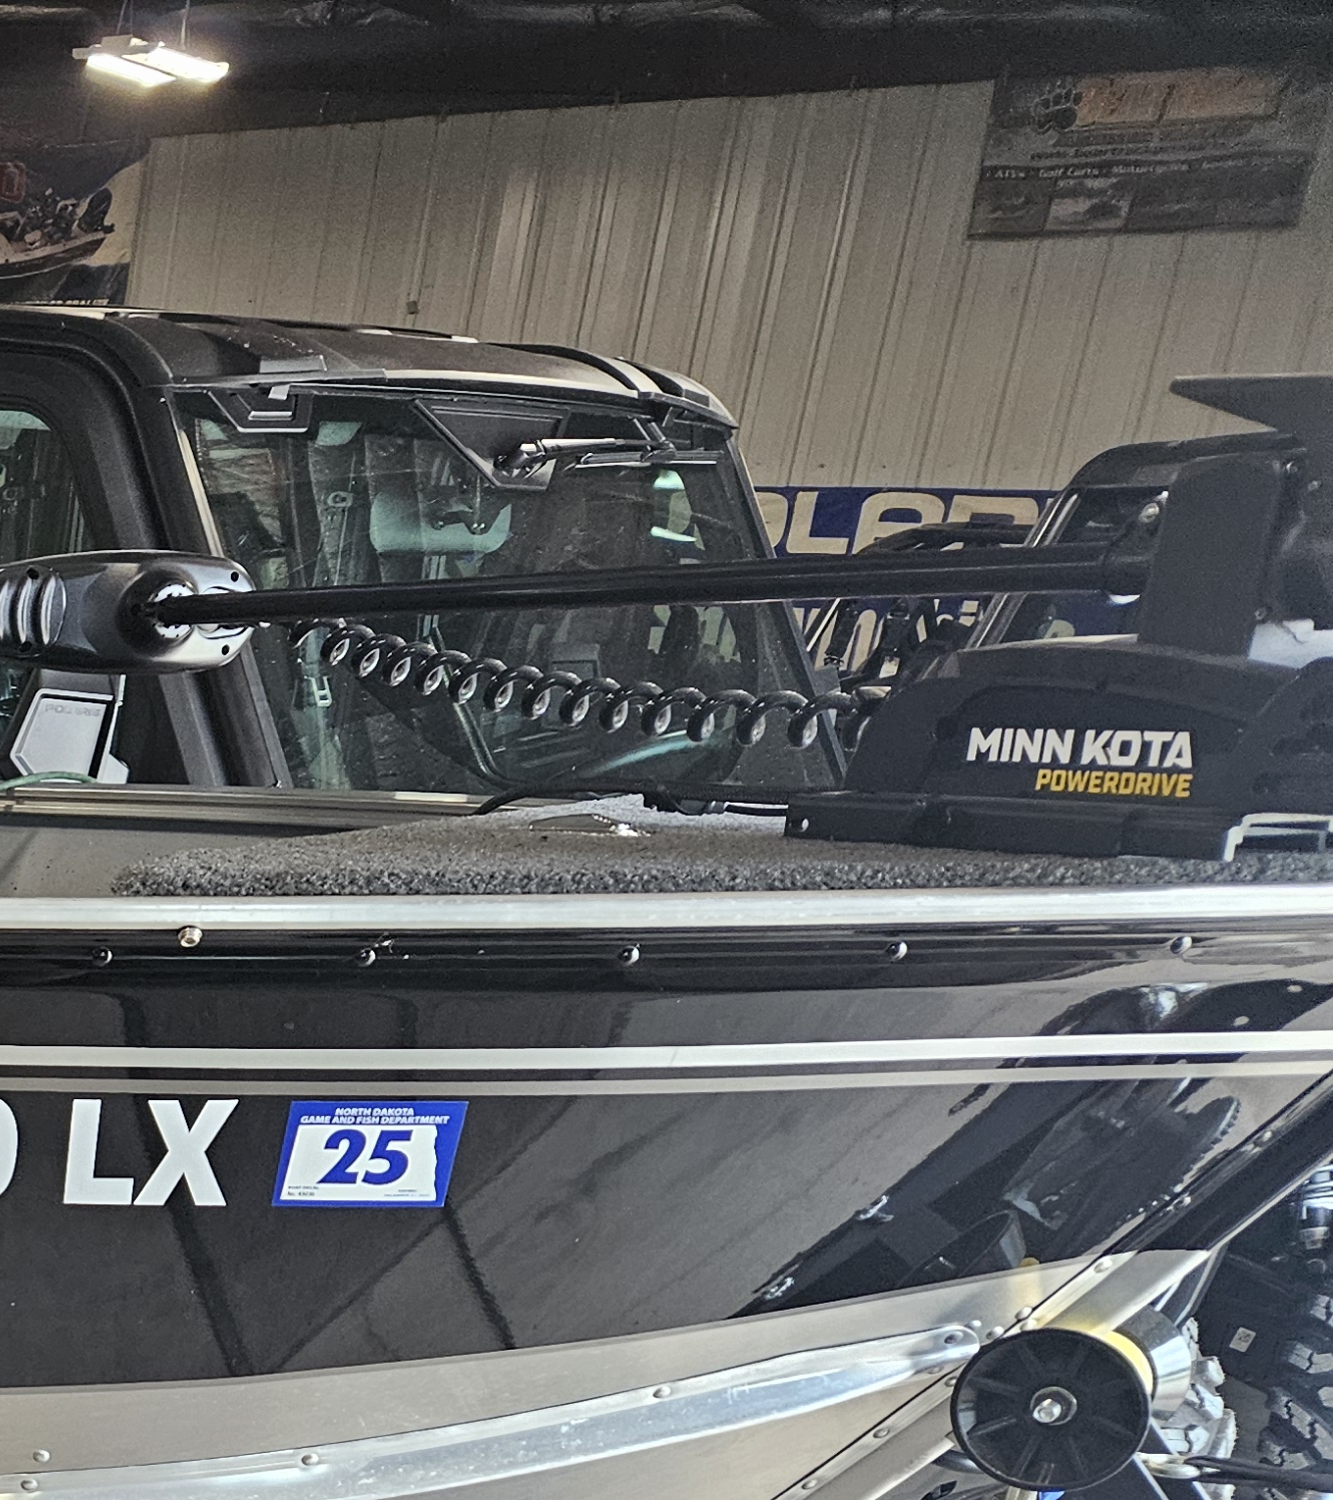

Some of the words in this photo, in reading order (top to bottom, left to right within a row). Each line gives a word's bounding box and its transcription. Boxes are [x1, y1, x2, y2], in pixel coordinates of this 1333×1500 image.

[966, 727, 1075, 764] MINN
[1080, 729, 1193, 769] KOTA
[1035, 768, 1193, 798] POWERDRIVE
[300, 1116, 331, 1124] GAME
[332, 1116, 355, 1124] AND
[356, 1116, 379, 1124] FISH
[380, 1116, 450, 1125] DEPARTMENT
[335, 1108, 371, 1116] NORTH
[372, 1108, 414, 1116] DAKOTA
[62, 1098, 239, 1207] LX
[316, 1129, 414, 1186] 25
